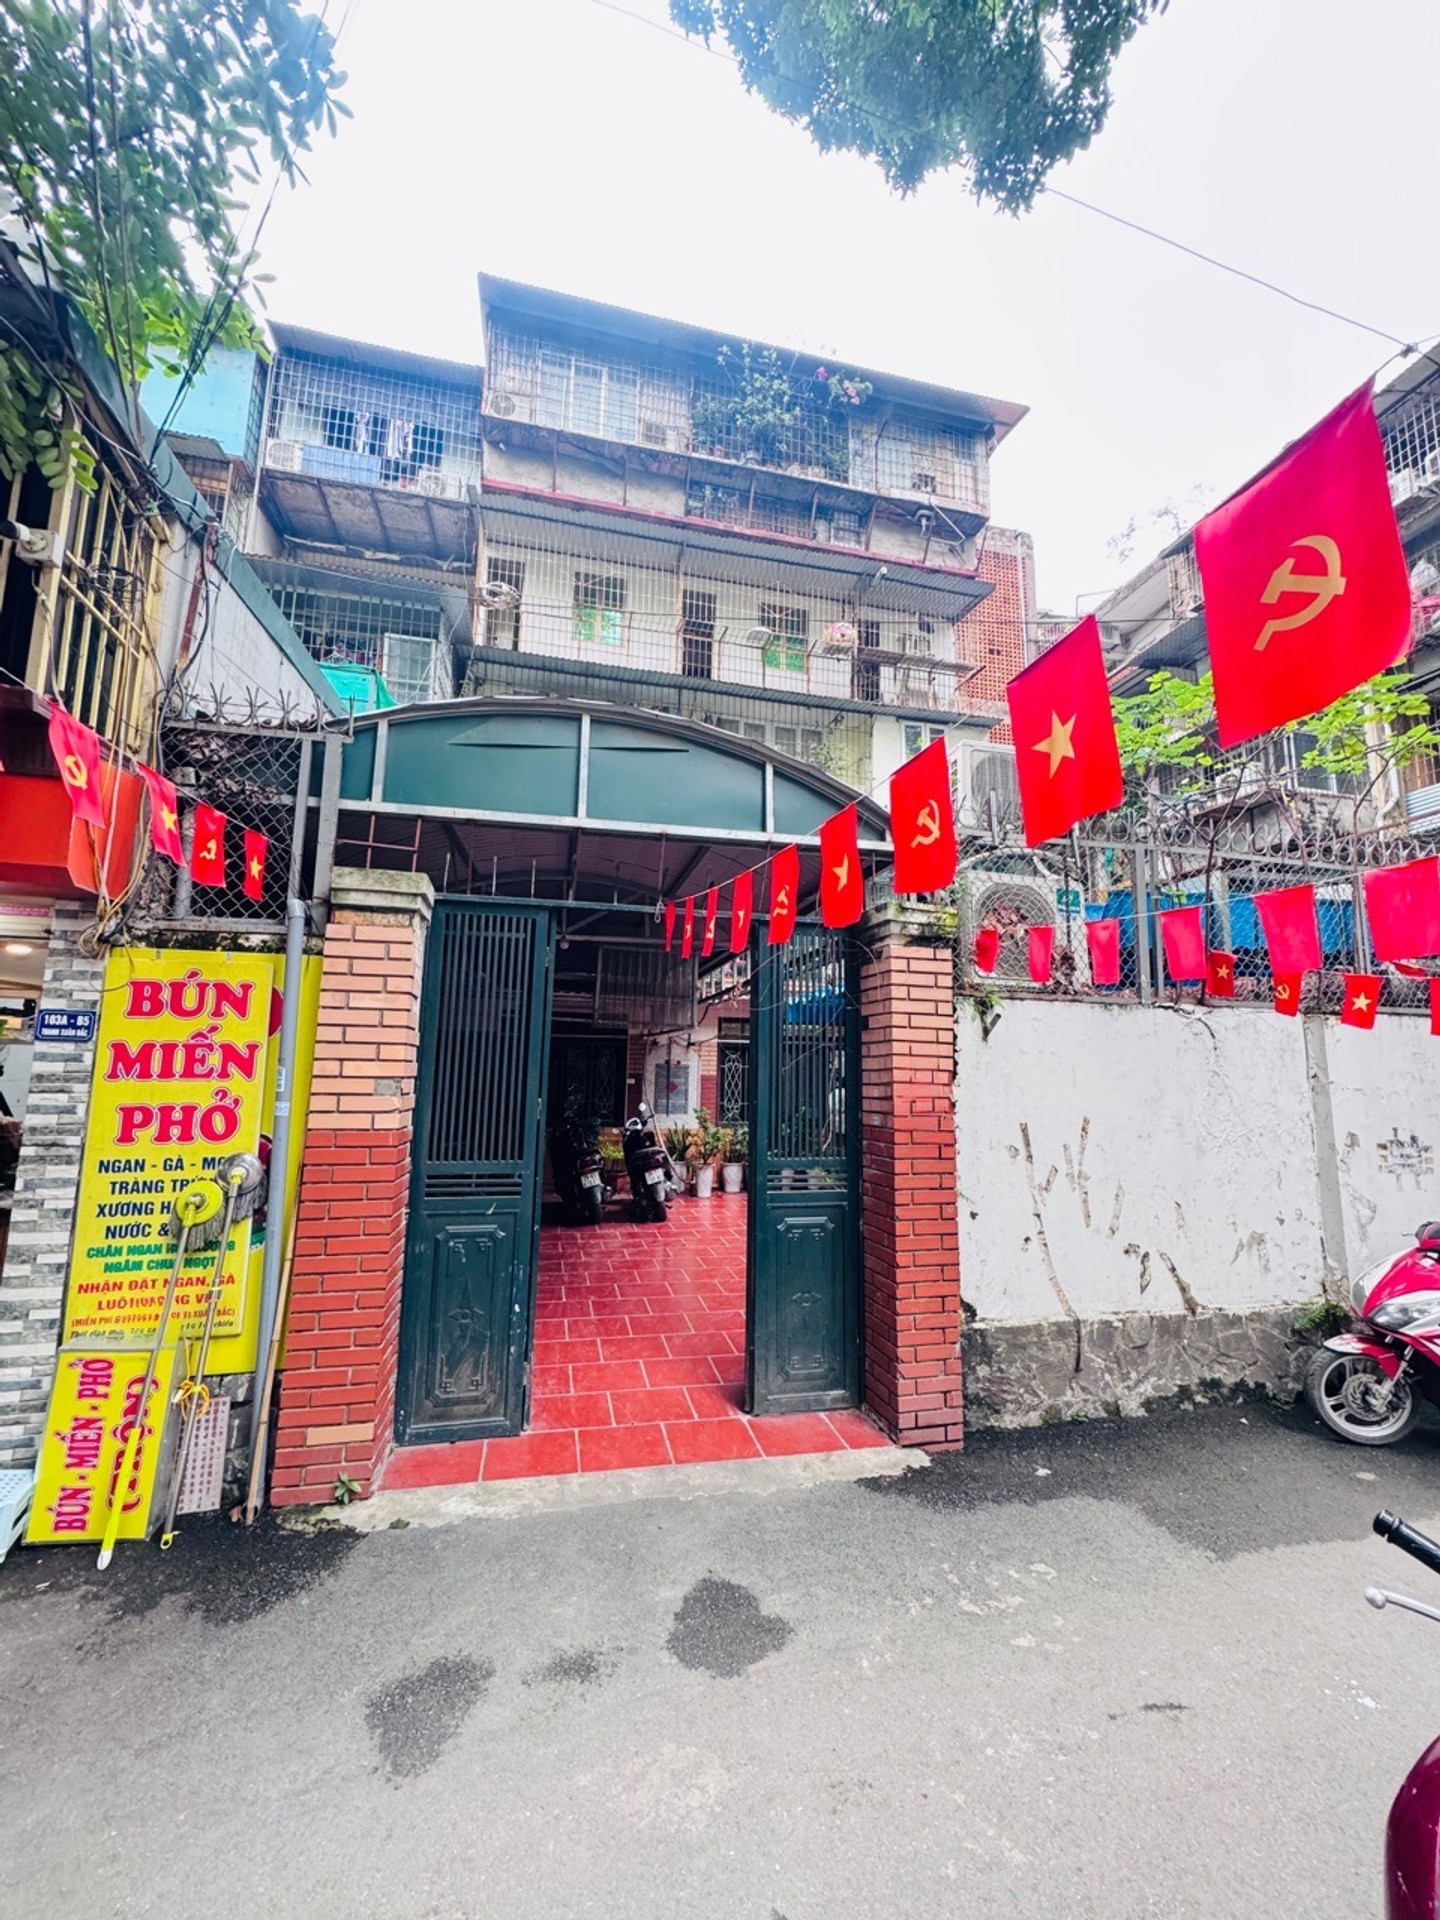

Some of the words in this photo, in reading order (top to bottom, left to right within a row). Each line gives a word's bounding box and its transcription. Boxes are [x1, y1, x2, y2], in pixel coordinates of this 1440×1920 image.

[126, 970, 254, 1020] BÚN
[44, 1014, 68, 1026] 103A
[77, 1015, 90, 1026] B5
[104, 1024, 262, 1082] MIẾN
[114, 1087, 242, 1146] PHỞ
[98, 1159, 146, 1174] NGAN
[163, 1154, 185, 1172] GÀ
[110, 1177, 165, 1195] TRÀNG
[96, 1200, 155, 1218] XƯƠNG
[105, 1221, 152, 1239] NƯỚC
[86, 1244, 123, 1258] CHÂN
[126, 1243, 163, 1256] NGAN
[147, 1258, 175, 1270] CHU
[68, 1356, 115, 1400] PHỞ
[54, 1416, 104, 1470] MIẾN
[47, 1486, 93, 1532] BÚN
